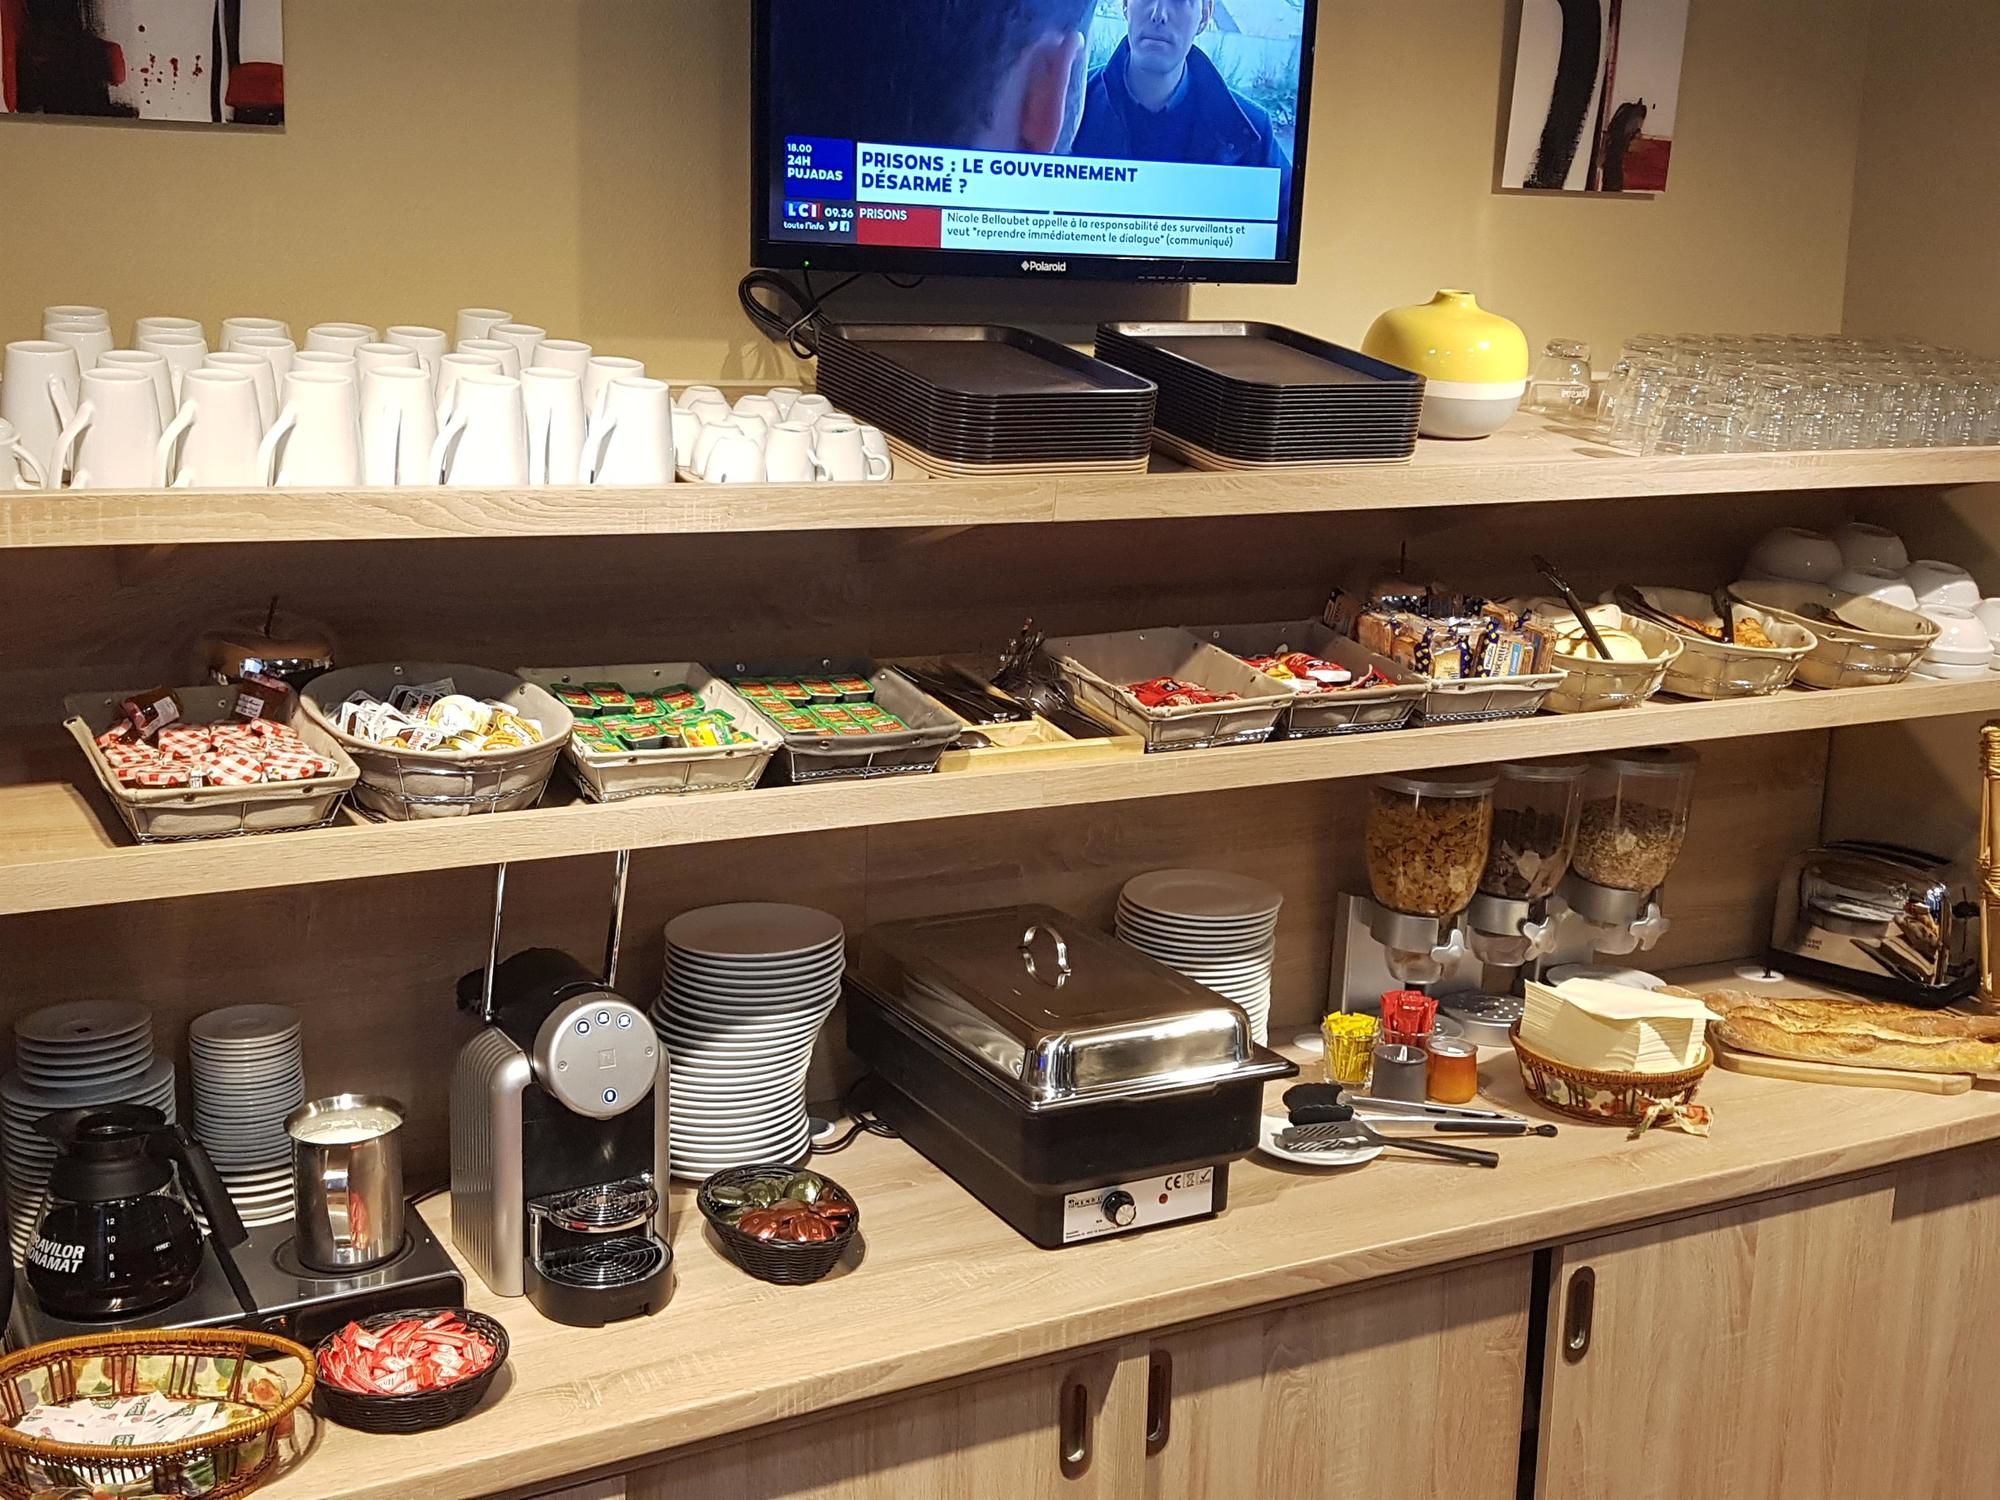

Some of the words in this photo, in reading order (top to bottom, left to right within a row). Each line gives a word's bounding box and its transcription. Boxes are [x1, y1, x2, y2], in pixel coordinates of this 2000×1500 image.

[787, 143, 813, 153] 18.00
[787, 155, 811, 166] 24H
[861, 151, 945, 172] PRISONS
[962, 158, 984, 174] LE
[989, 159, 1138, 183] GOUVERNEMENT
[787, 167, 843, 181] PUJADAS
[861, 169, 953, 193] DÉSARMÉ
[959, 178, 968, 194] ?
[788, 203, 818, 217] LCI
[824, 207, 854, 218] 09.36
[859, 208, 908, 221] PRISONS
[947, 212, 979, 224] Nicole
[981, 214, 1030, 226] Belloubet
[1032, 216, 1068, 229] appelle
[1079, 218, 1088, 229] la
[1090, 220, 1159, 232] responsabilité
[1160, 222, 1177, 232] des
[1179, 223, 1234, 234] surveillants
[1235, 225, 1246, 235] et
[947, 227, 970, 237] veut
[1028, 229, 1106, 242] immédiatement
[1108, 233, 1117, 243] le
[1166, 233, 1234, 249] (communiqué)
[1029, 261, 1066, 272] Polaroid
[1164, 1174, 1182, 1191] CE
[106, 1217, 115, 1226] 12
[106, 1235, 116, 1244] 10
